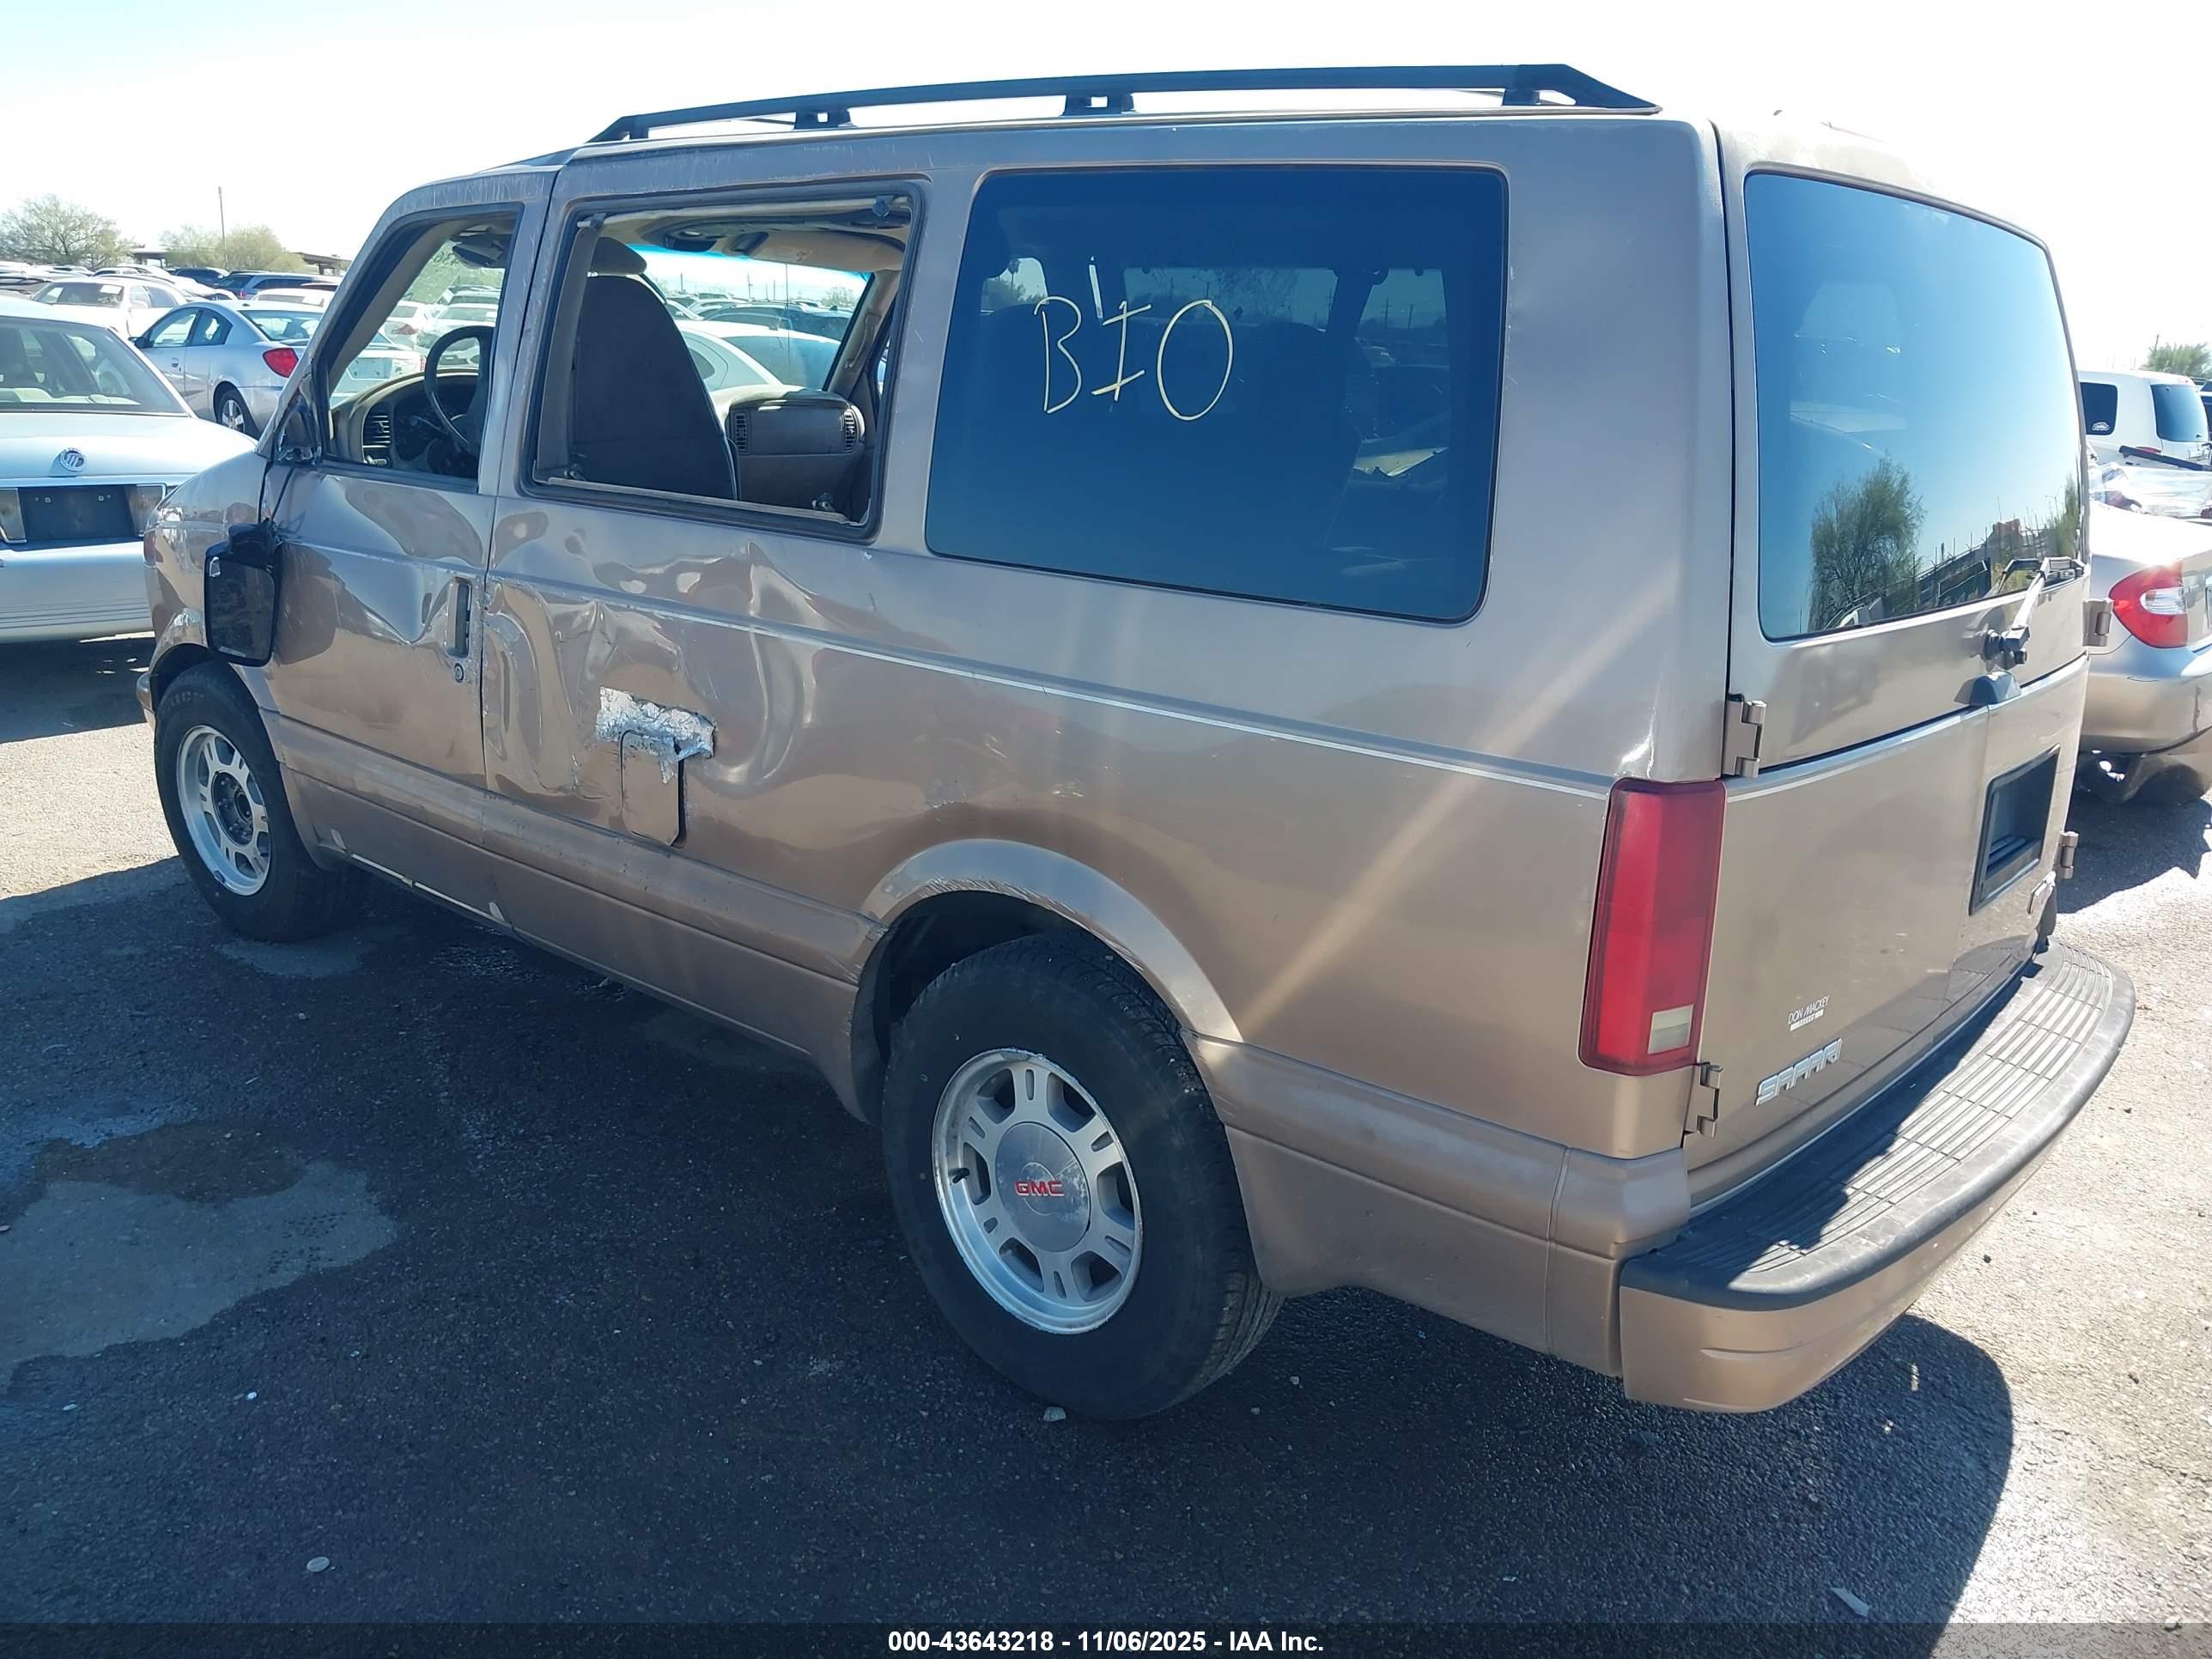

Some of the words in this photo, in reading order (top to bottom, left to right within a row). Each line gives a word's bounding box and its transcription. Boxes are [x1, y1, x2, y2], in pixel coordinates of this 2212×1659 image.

[1033, 295, 1234, 421] BIO
[1788, 1008, 1803, 1024] DON
[1804, 994, 1830, 1018] MACKEY
[1755, 1037, 1842, 1106] SAFARI
[1015, 1181, 1065, 1196] GMC
